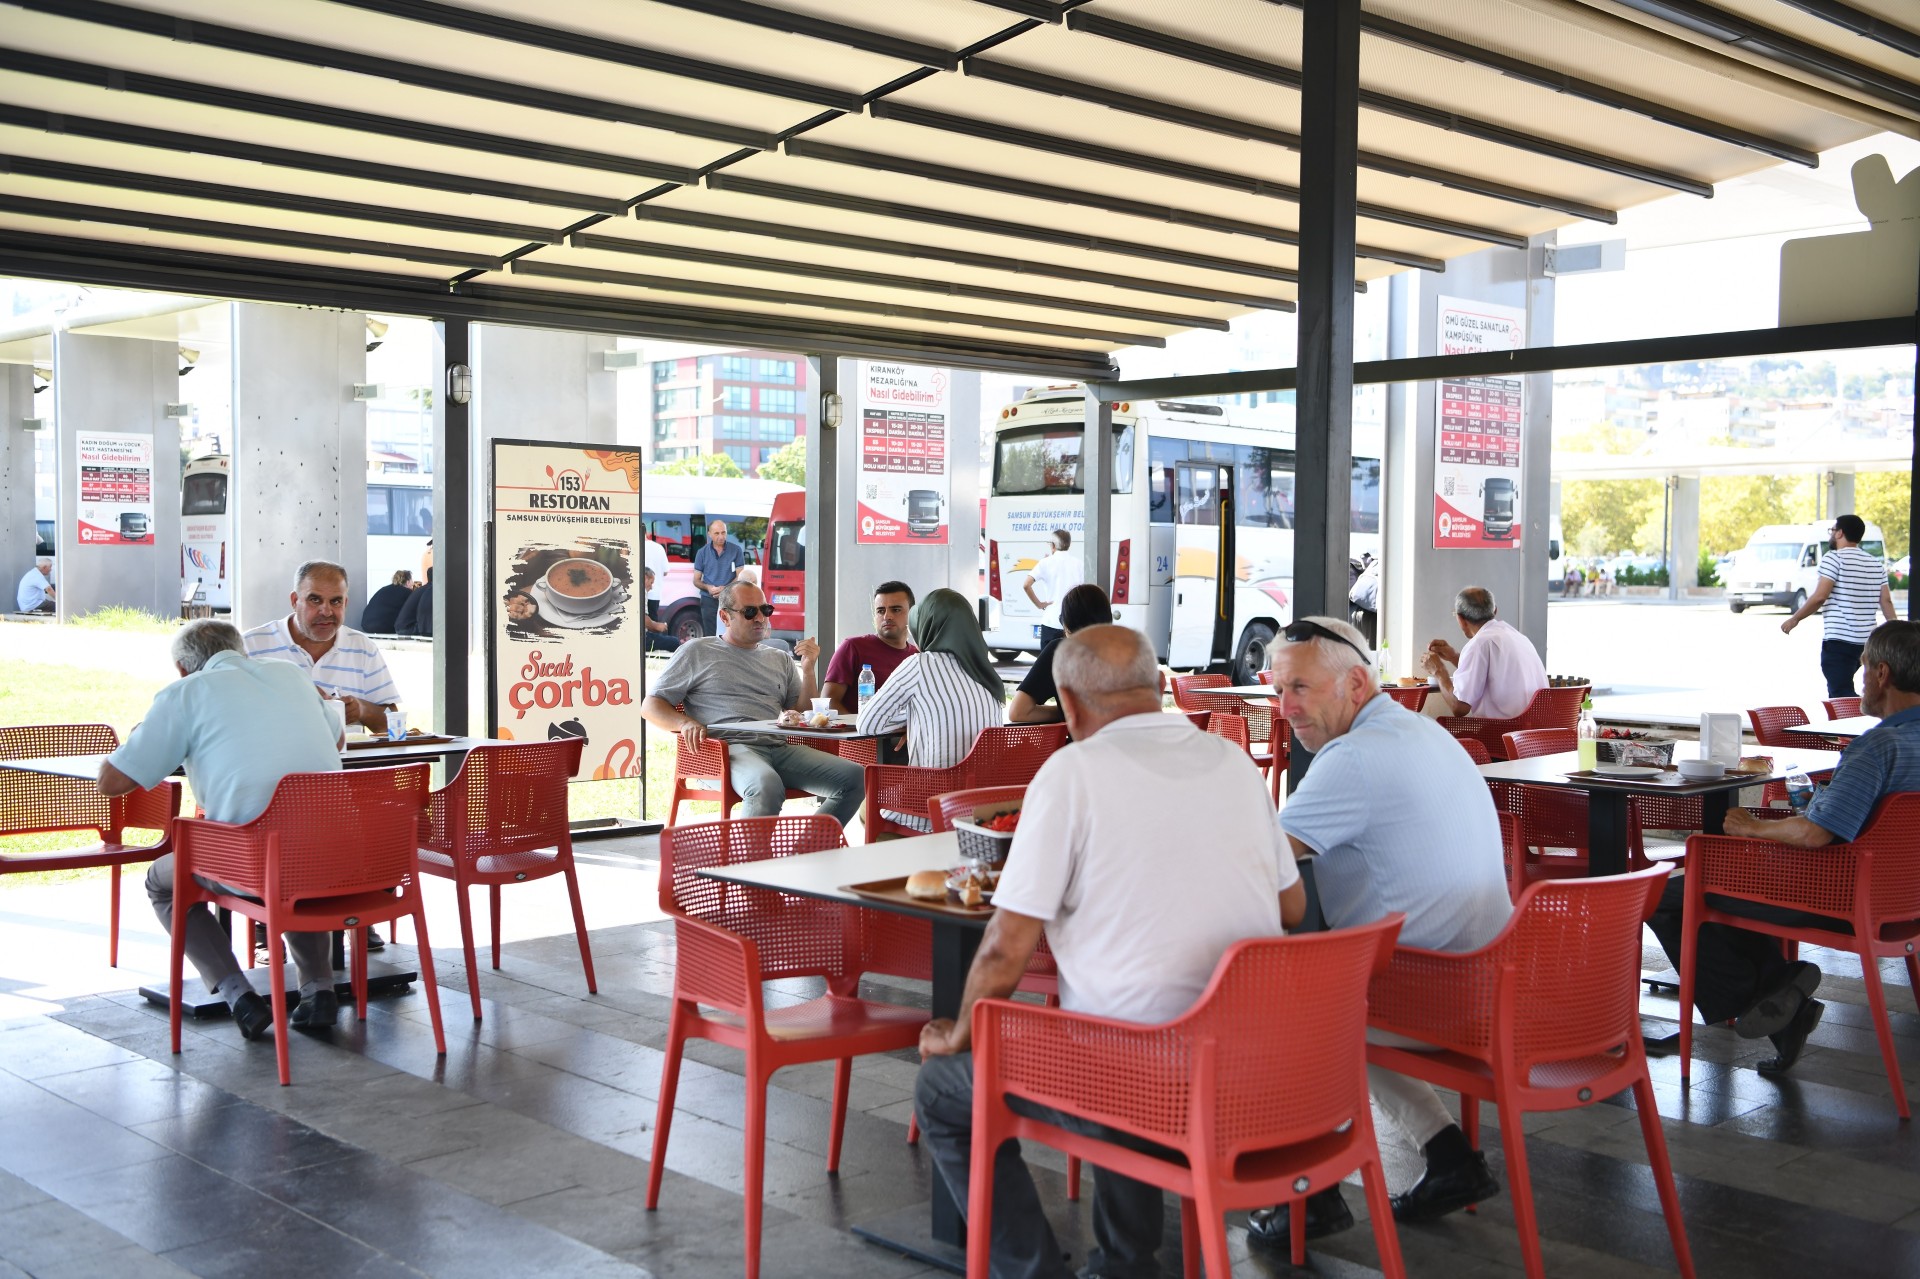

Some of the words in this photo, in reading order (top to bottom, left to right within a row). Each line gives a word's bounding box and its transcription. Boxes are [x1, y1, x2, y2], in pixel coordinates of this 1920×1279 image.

[1460, 316, 1478, 329] GÜZEL
[1480, 321, 1509, 333] SANATLAR
[1445, 330, 1482, 343] KAMPÜSÜ'NE
[871, 366, 904, 375] KIRANKÖY
[871, 377, 917, 387] MEZARLIĞI'NA
[870, 388, 889, 399] Nasıl
[892, 389, 934, 402] Gidebilirim
[102, 454, 140, 462] Gidebilirim
[560, 476, 580, 491] 153
[530, 494, 610, 510] RESTORAN
[507, 514, 539, 522] SAMSUN
[541, 514, 589, 524] BÜYÜKŞEHİR
[590, 516, 631, 525] BELEDİYESİ
[1008, 511, 1031, 519] SAMSUN
[1032, 509, 1071, 519] BÜYÜKŞEHİR
[1012, 523, 1031, 531] TERME
[1033, 521, 1048, 531] ÖZEL
[1156, 556, 1168, 572] 24
[521, 650, 574, 681] Sıcak
[508, 666, 633, 720] çorba
